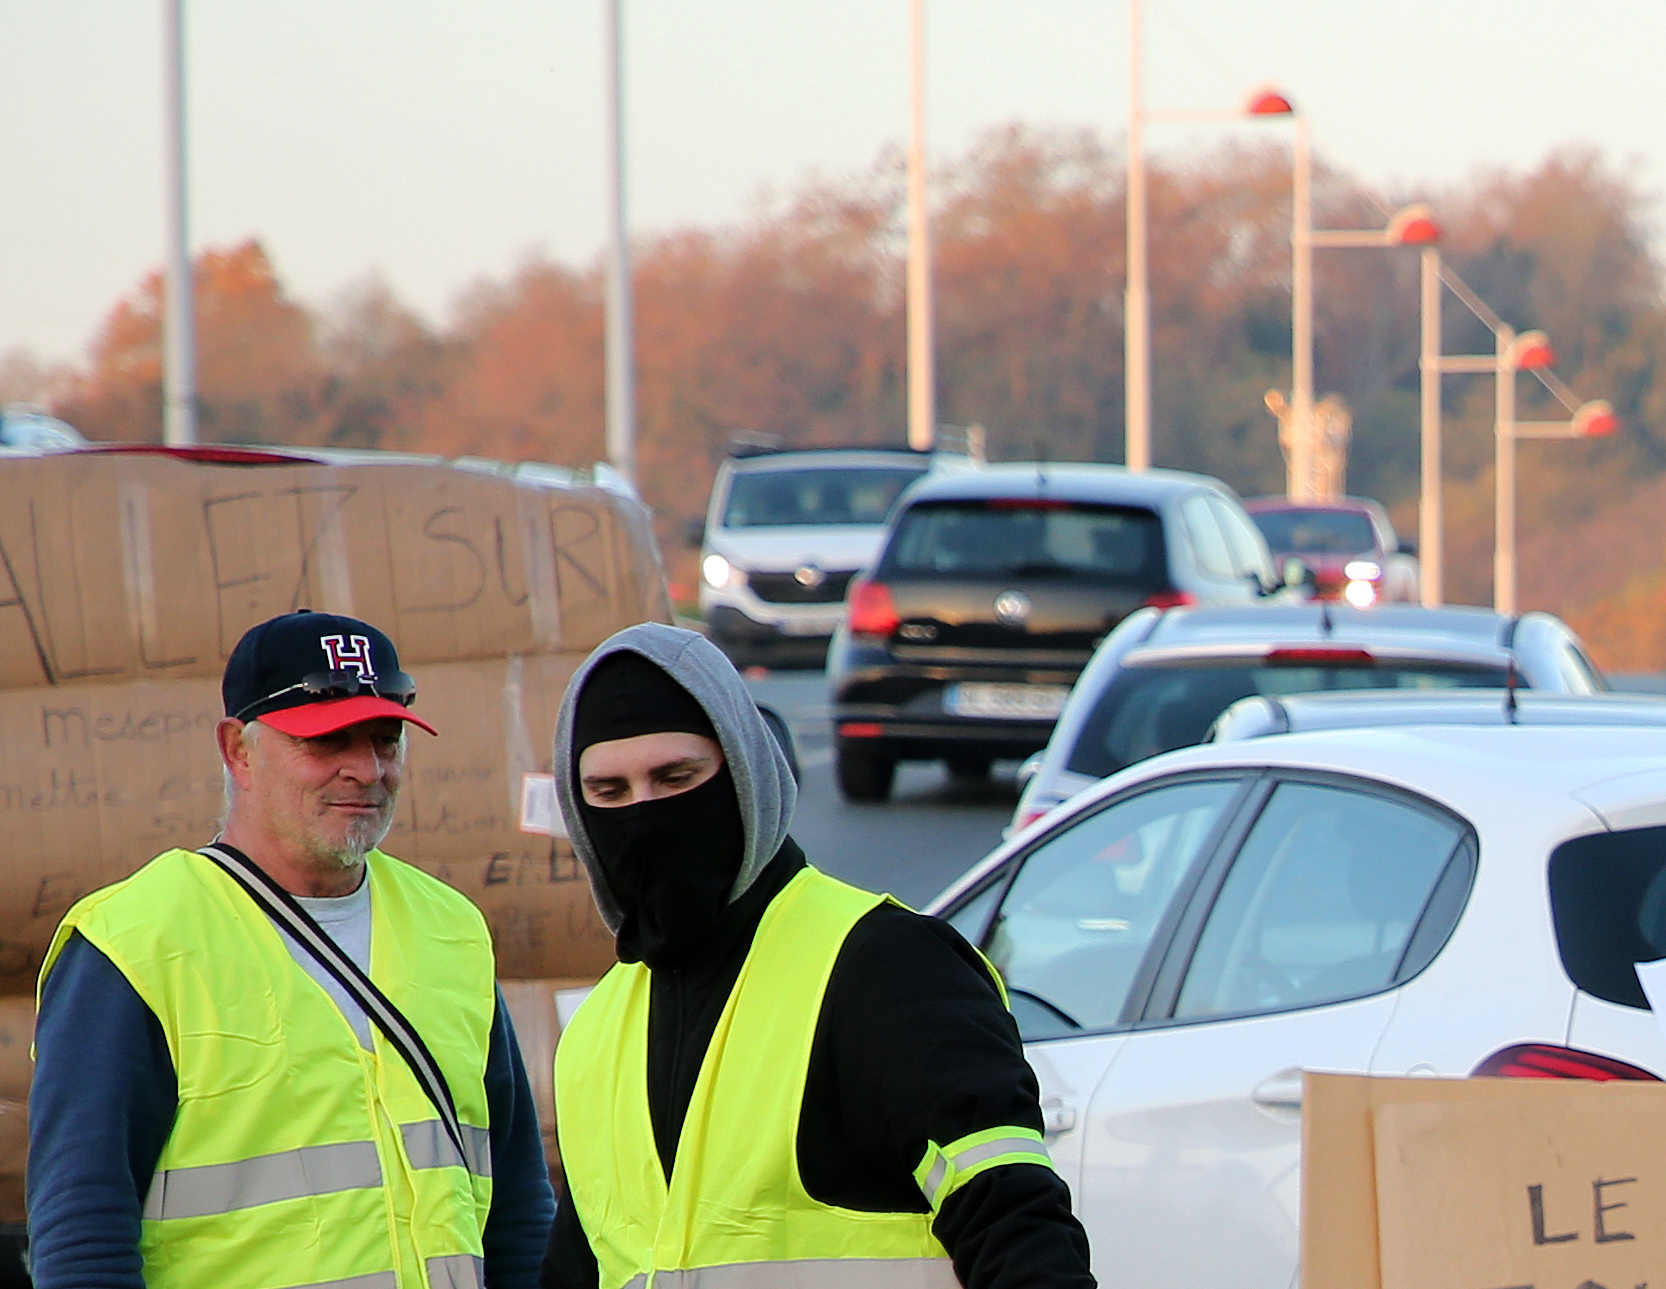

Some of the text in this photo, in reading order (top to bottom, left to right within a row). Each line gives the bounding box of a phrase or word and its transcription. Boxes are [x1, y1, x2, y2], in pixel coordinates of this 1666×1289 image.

[400, 504, 612, 612] SUR
[320, 634, 379, 684] H
[1526, 1177, 1638, 1246] LE
